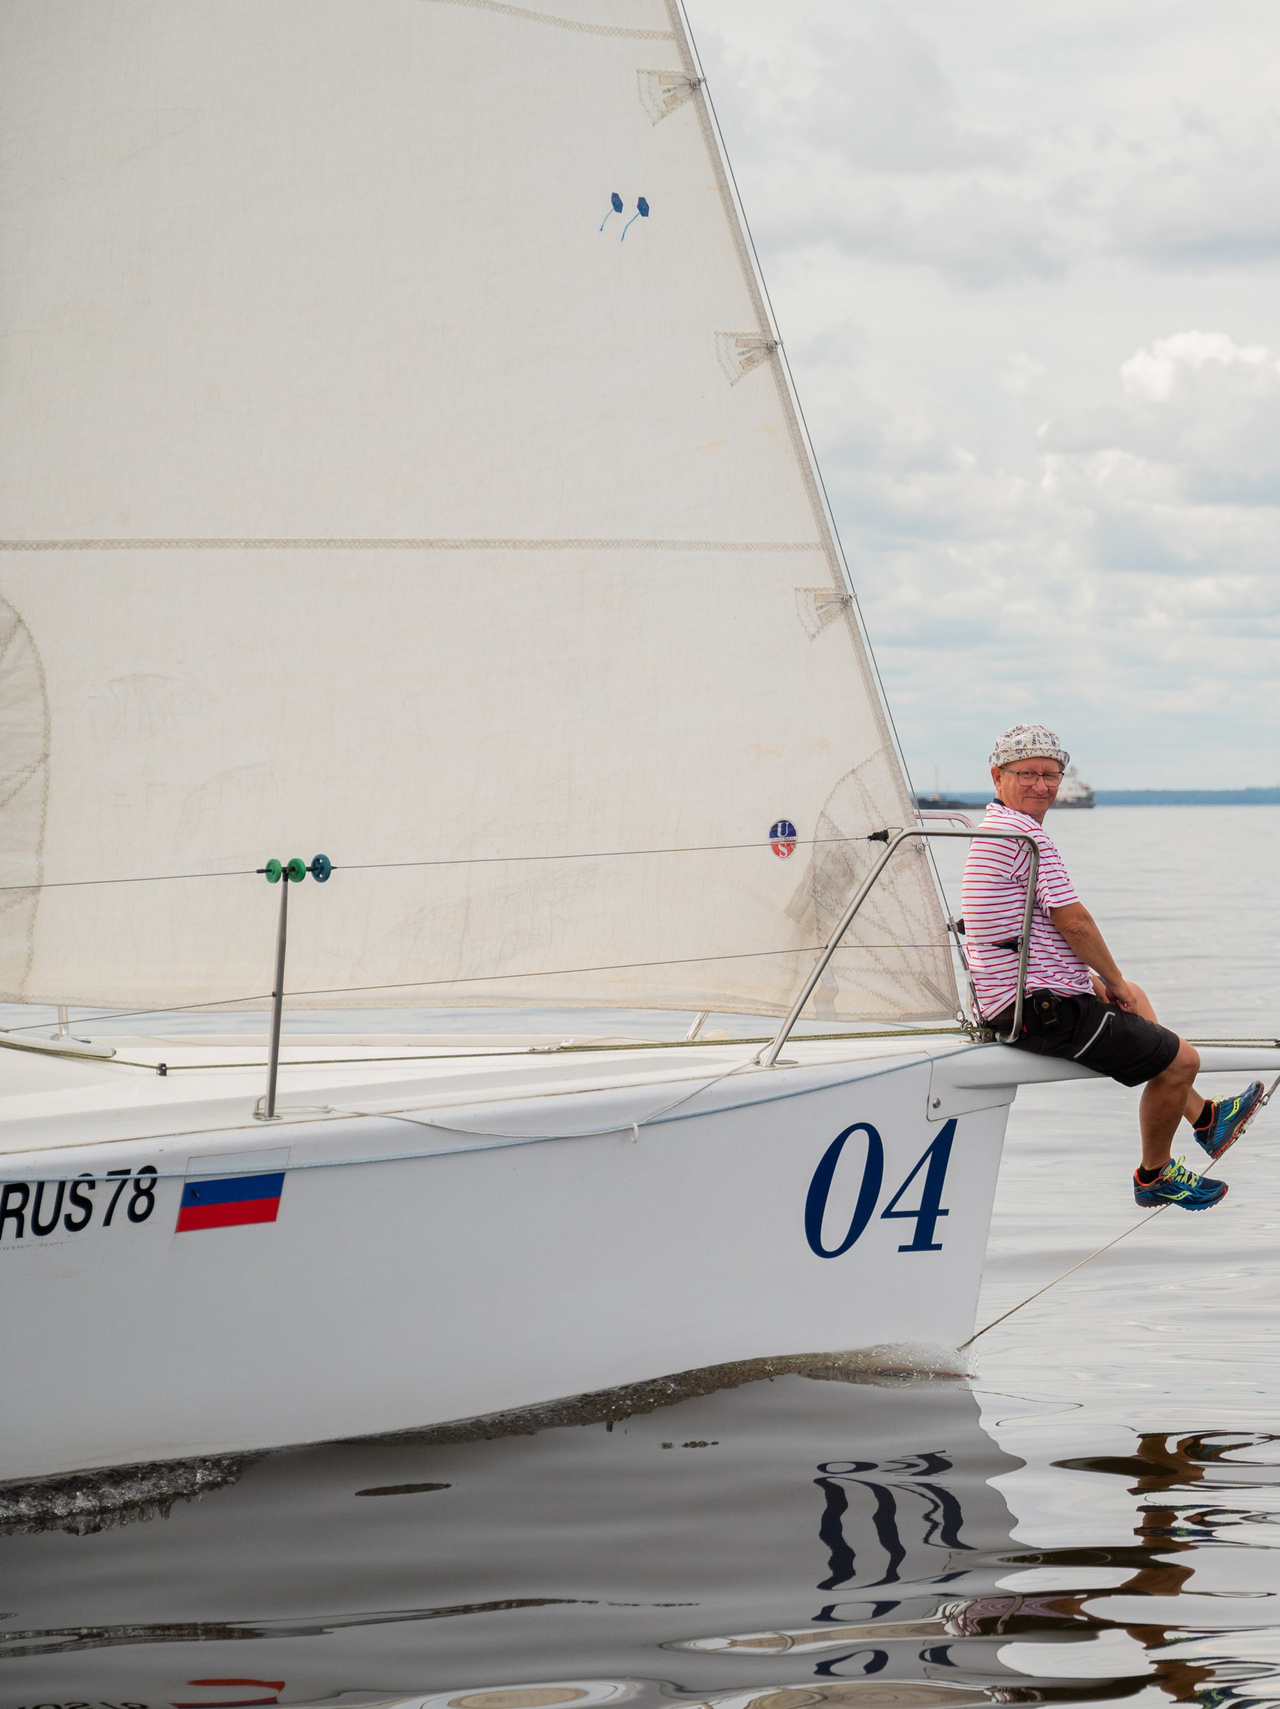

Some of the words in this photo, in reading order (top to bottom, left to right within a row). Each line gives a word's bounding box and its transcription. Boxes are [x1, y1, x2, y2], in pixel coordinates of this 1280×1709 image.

[777, 822, 790, 837] U
[778, 842, 788, 858] S
[804, 1118, 958, 1259] 04
